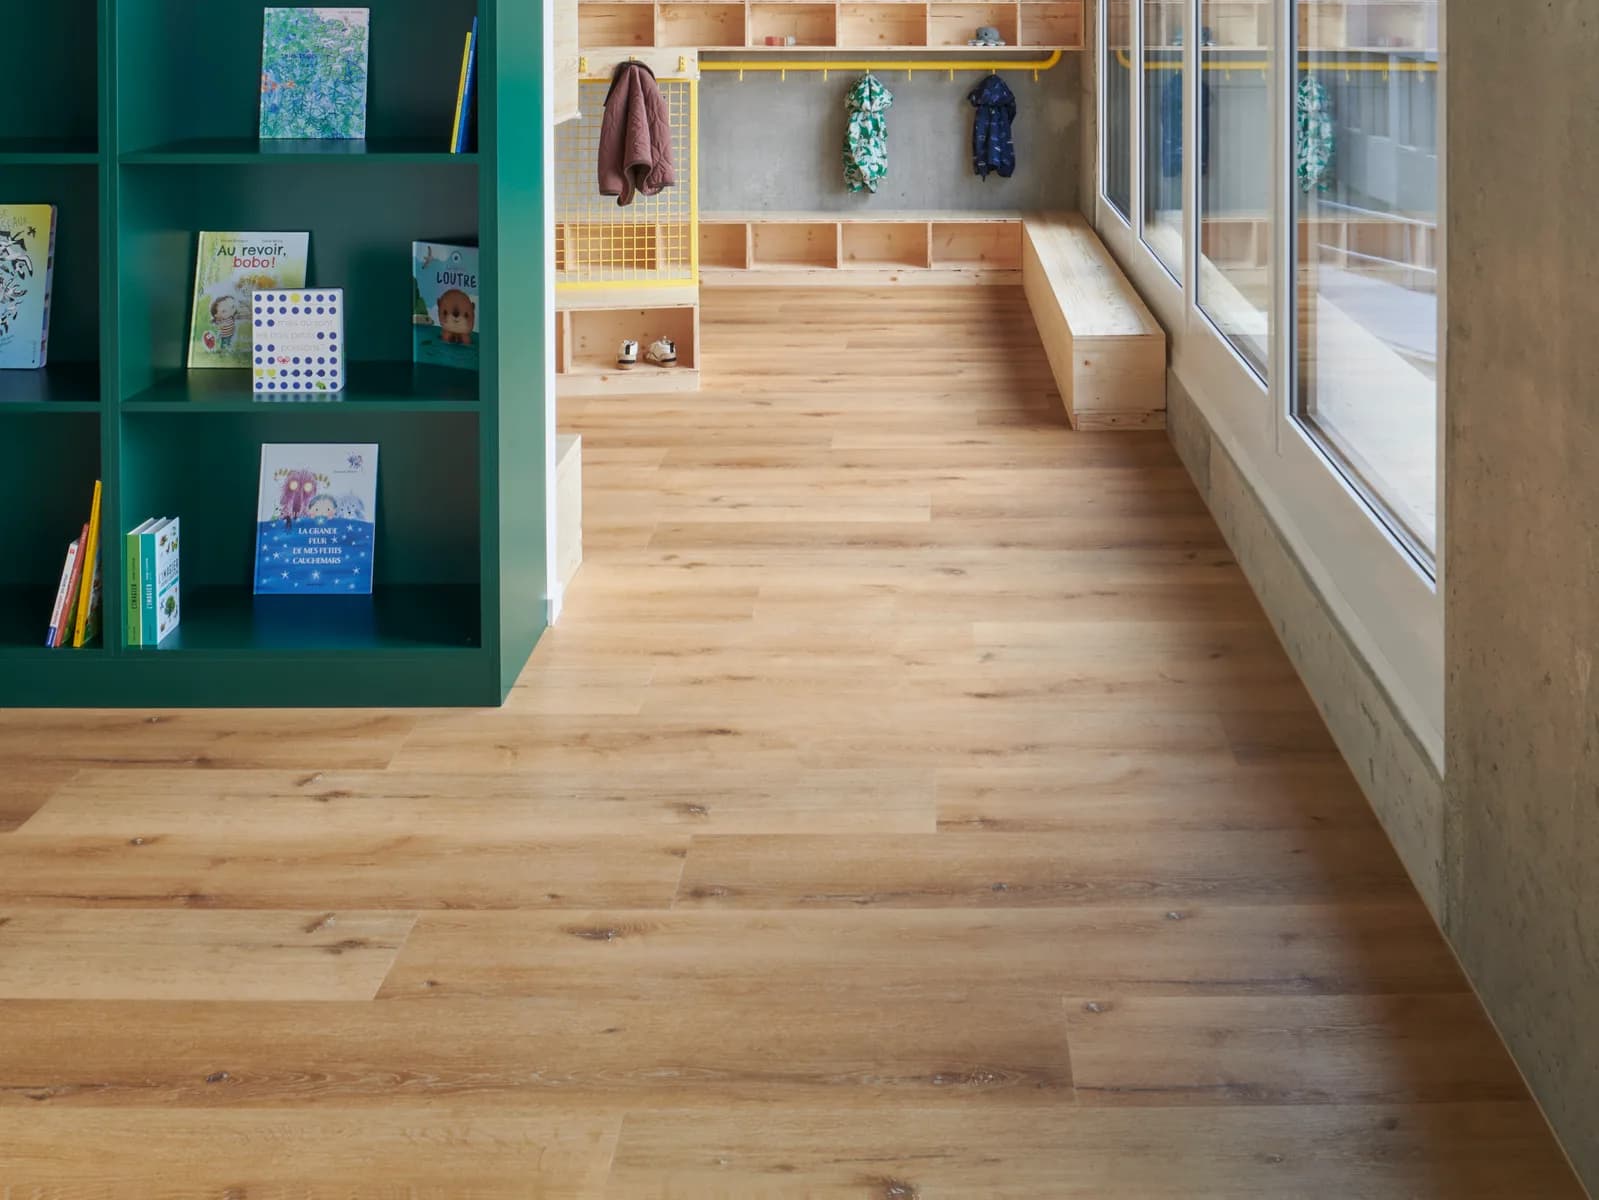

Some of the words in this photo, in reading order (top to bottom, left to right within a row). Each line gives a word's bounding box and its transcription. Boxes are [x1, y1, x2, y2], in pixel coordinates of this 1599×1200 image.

[216, 245, 236, 257] Au
[242, 243, 287, 257] revoir,
[436, 271, 477, 288] LOUTRE
